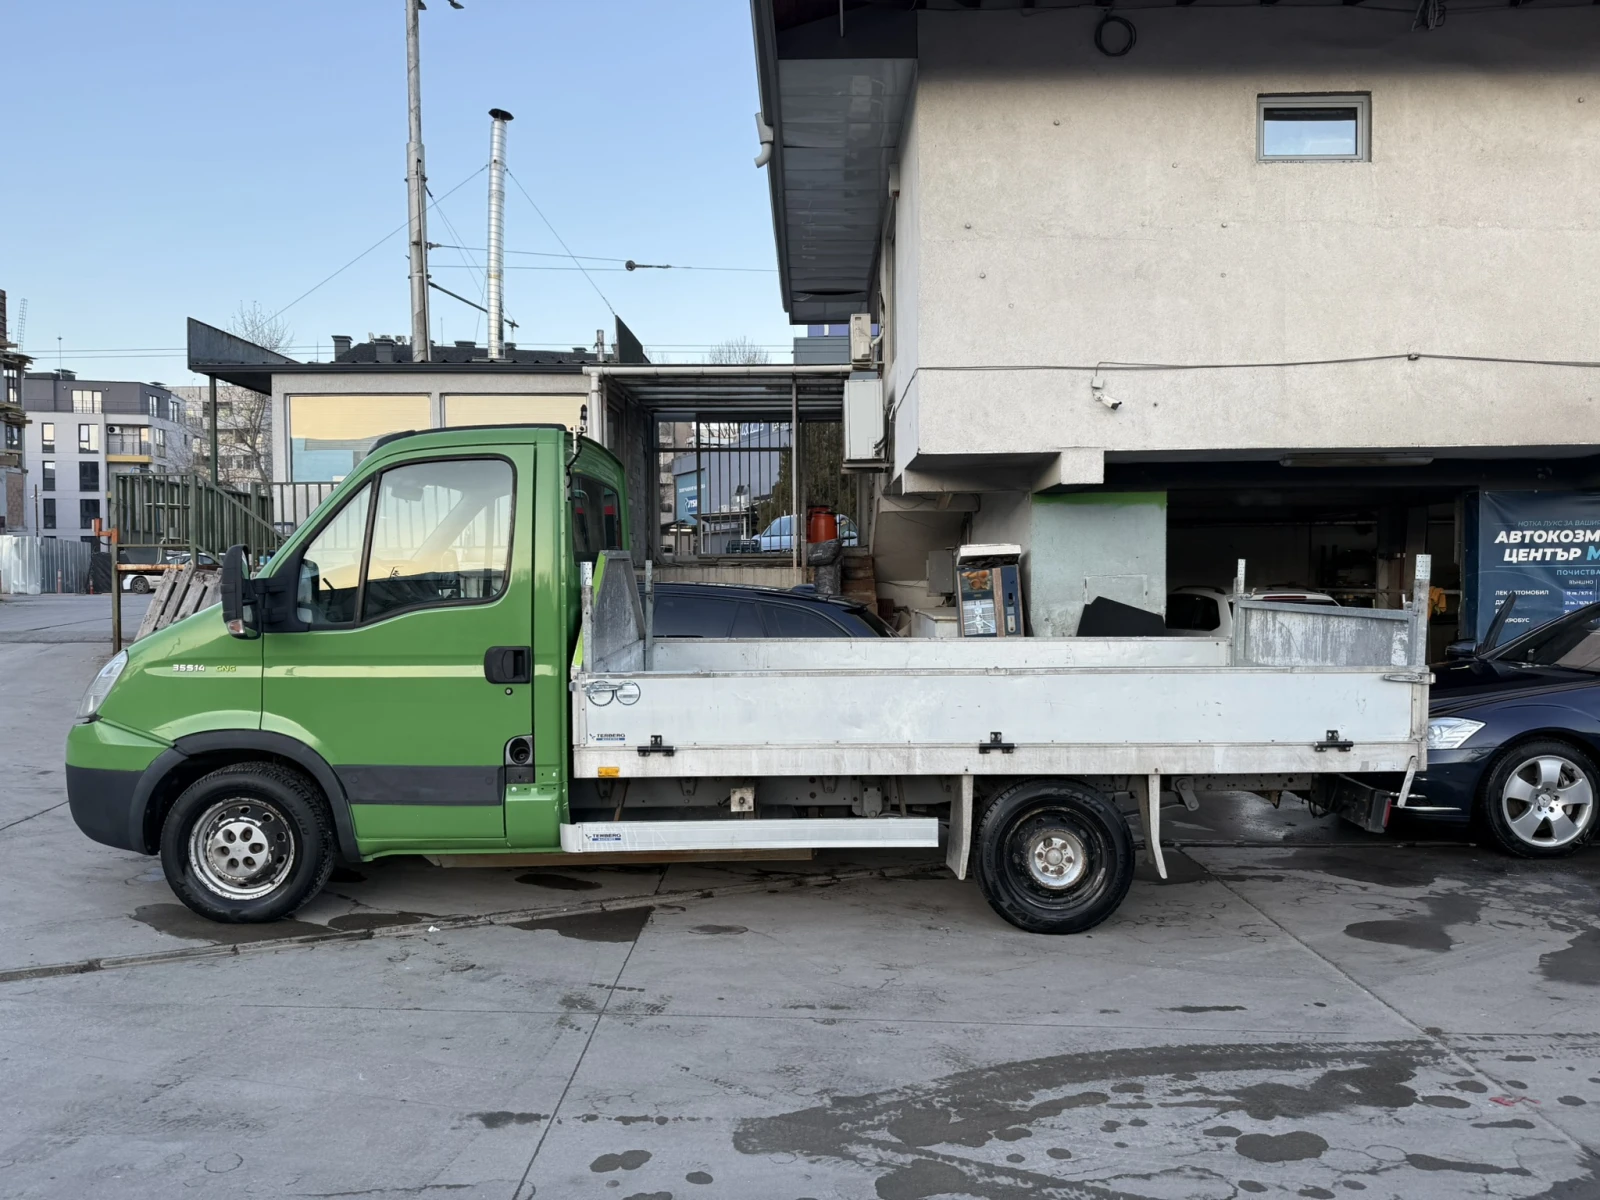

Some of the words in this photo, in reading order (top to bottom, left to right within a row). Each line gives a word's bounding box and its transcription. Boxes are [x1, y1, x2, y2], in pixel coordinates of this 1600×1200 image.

[1494, 530, 1600, 544] АВТОКОЗМ
[1503, 548, 1581, 564] ЦЕНТЪР
[173, 664, 206, 672] 35S14
